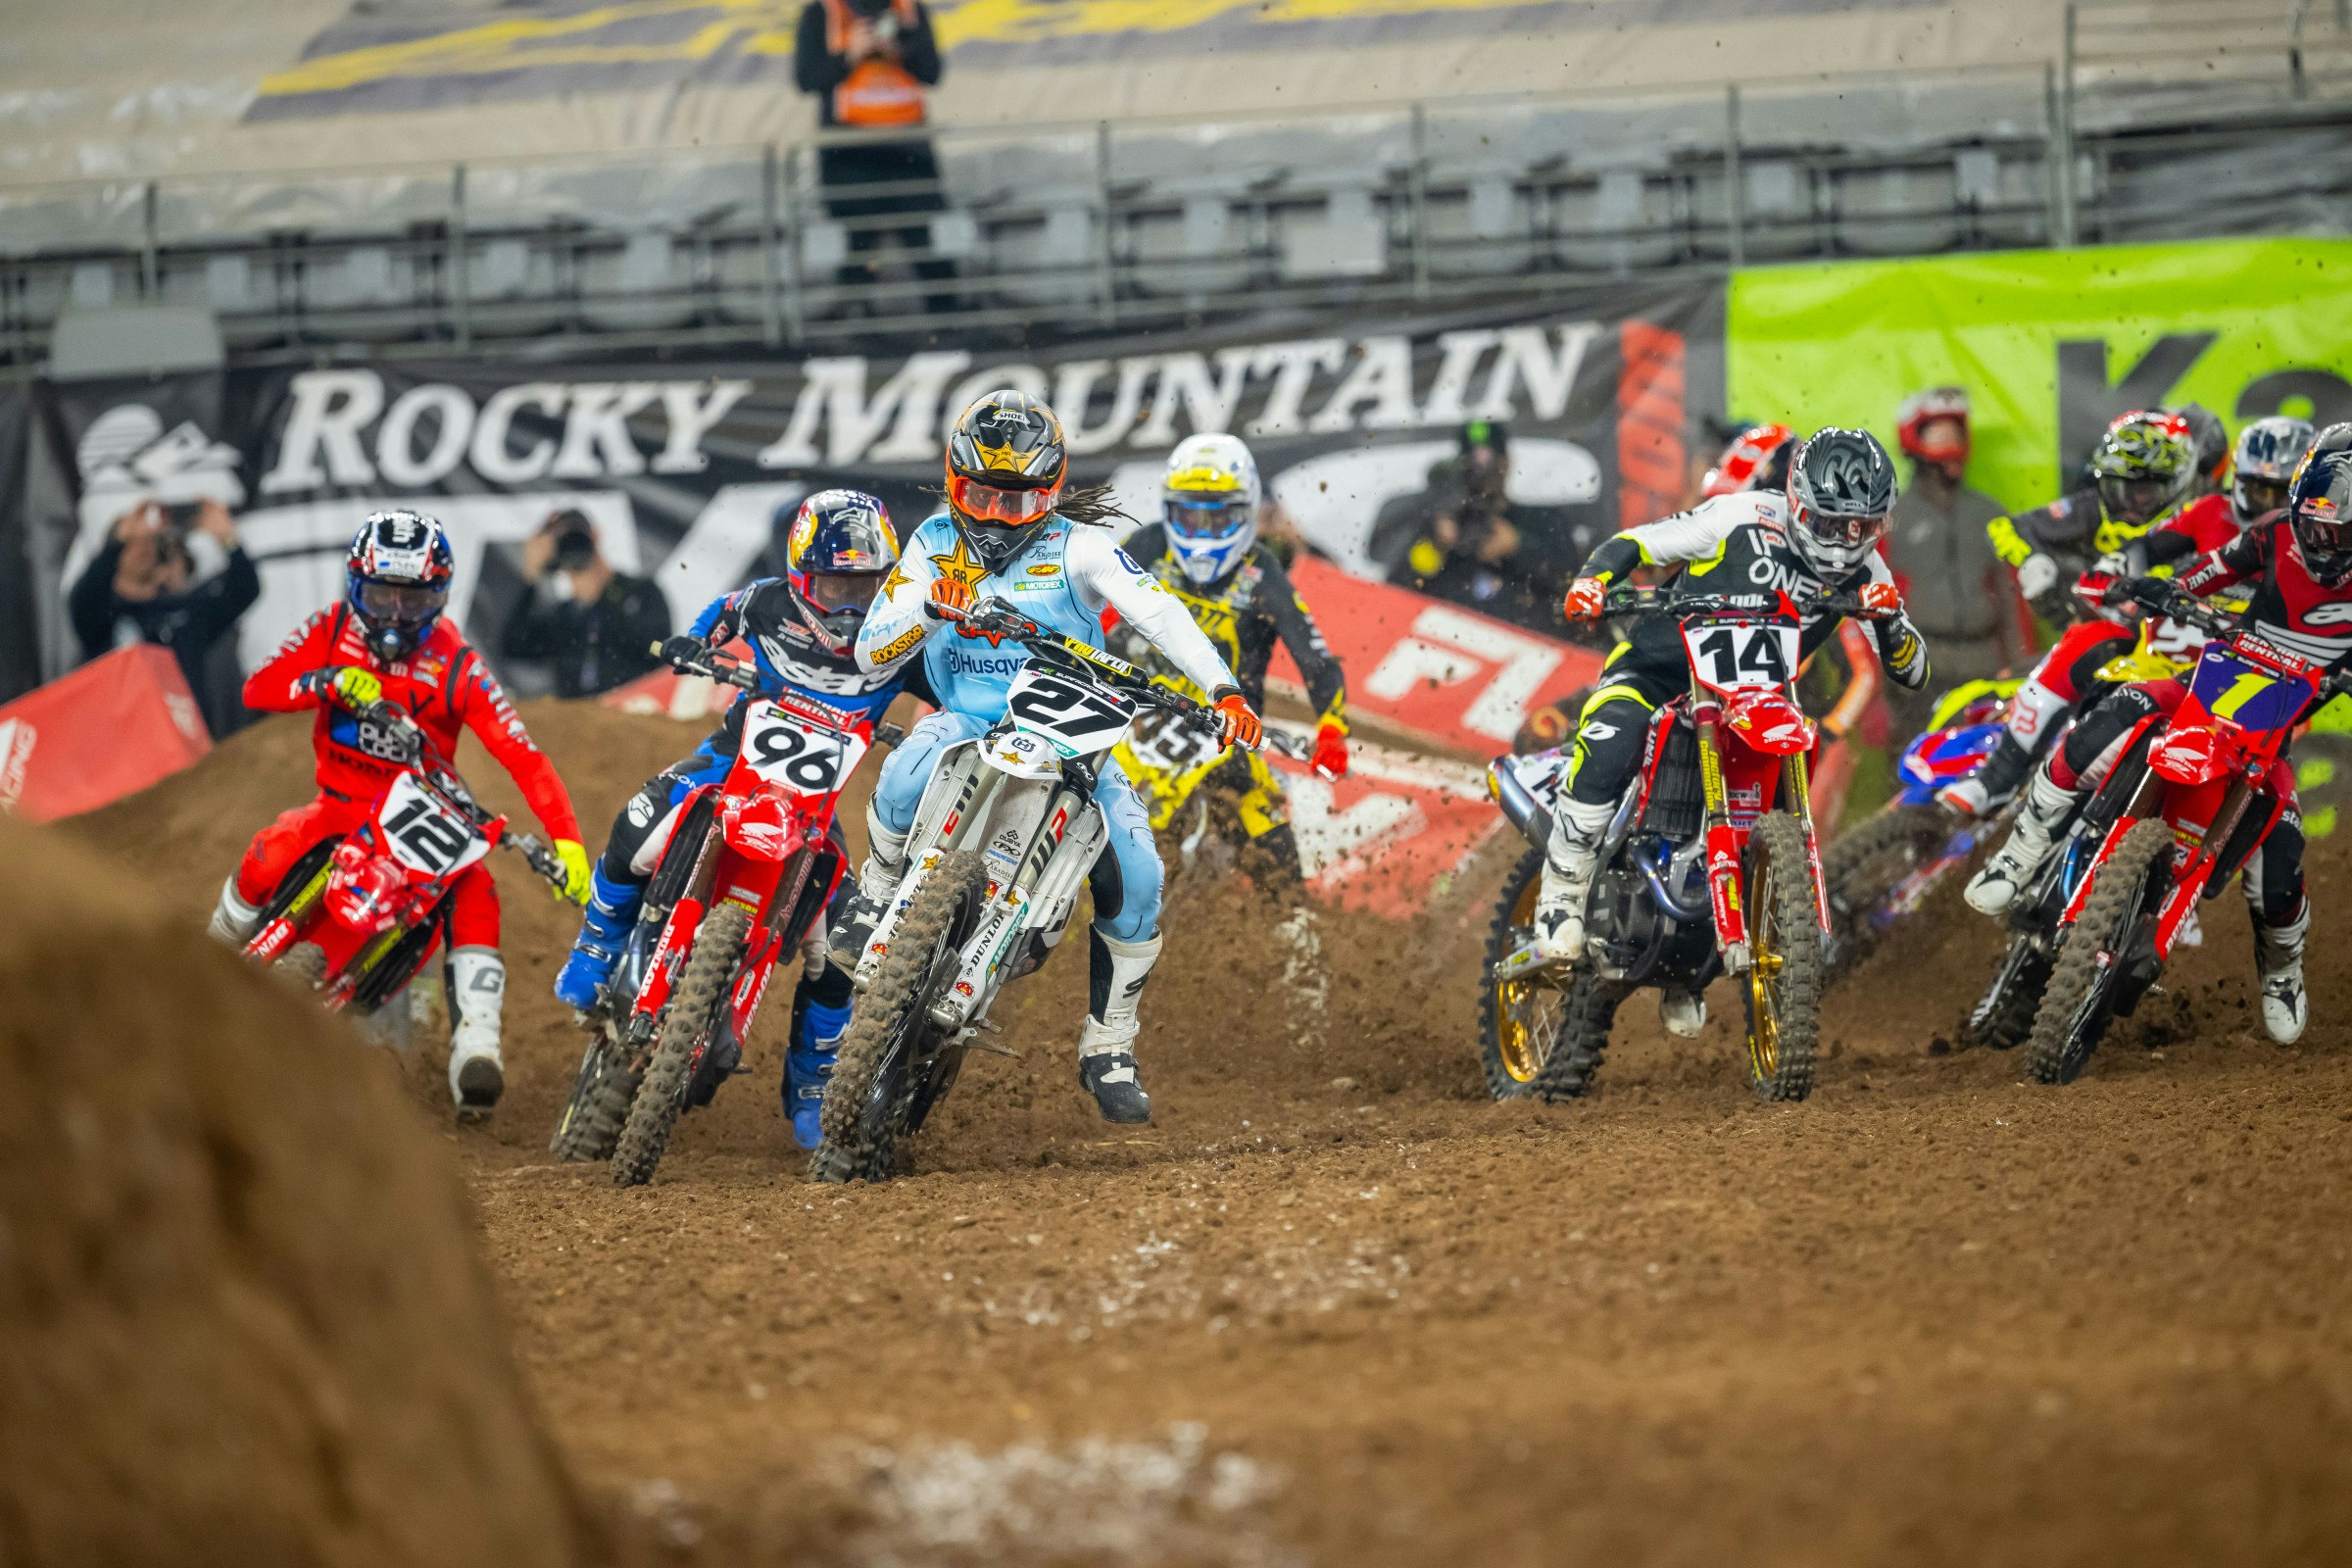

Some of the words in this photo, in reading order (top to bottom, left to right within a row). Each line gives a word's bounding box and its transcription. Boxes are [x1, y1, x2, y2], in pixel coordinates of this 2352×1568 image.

[259, 369, 753, 490] ROCKY
[1025, 581, 1062, 590] MOTOREX
[869, 623, 925, 665] ROCKSTAR
[1698, 629, 1788, 685] 14
[2238, 640, 2299, 669] RENTHAL
[784, 695, 848, 727] RENTHAL
[1009, 677, 1131, 738] 27
[2211, 673, 2278, 720] 1
[753, 726, 837, 789] 96
[382, 798, 470, 872] 12
[999, 834, 1021, 848] DUBYA
[2165, 880, 2204, 955] DUNLOP
[641, 924, 675, 998] DUNLOP
[742, 962, 772, 1039] DUNLOP
